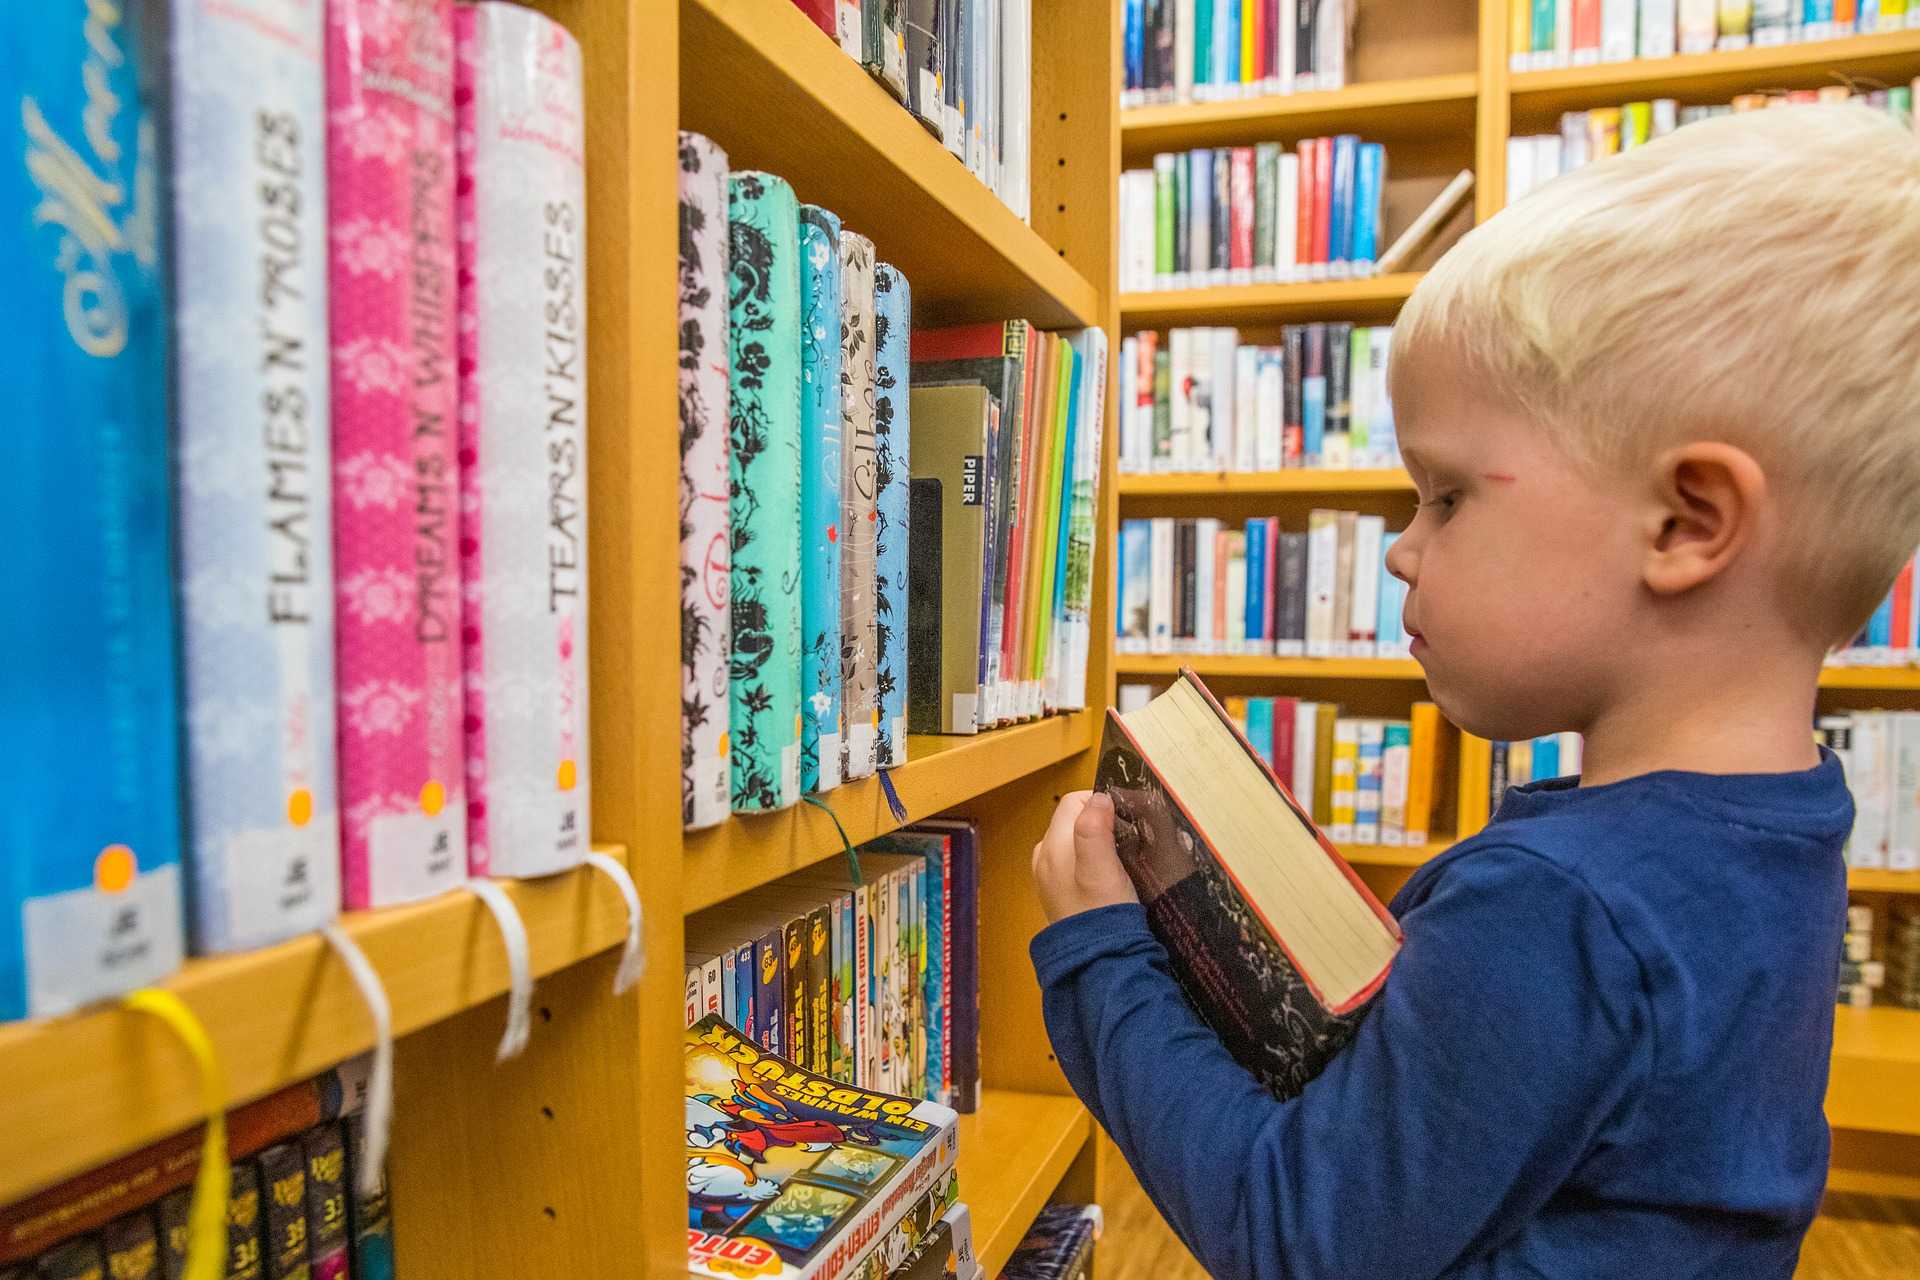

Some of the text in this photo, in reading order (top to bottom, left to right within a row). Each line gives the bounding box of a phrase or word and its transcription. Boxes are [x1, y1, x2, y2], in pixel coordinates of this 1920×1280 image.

[254, 110, 304, 309] ROSES
[543, 201, 577, 382] KISSES
[260, 386, 312, 627] FLAMES
[547, 439, 580, 613] TEARS
[963, 457, 976, 503] PIPER
[414, 453, 448, 642] DREAMS
[707, 969, 717, 984] 60
[741, 951, 752, 962] 433
[820, 978, 828, 1077] PEZIAL
[772, 1084, 879, 1122] WAHRES
[884, 1113, 929, 1133] EIN
